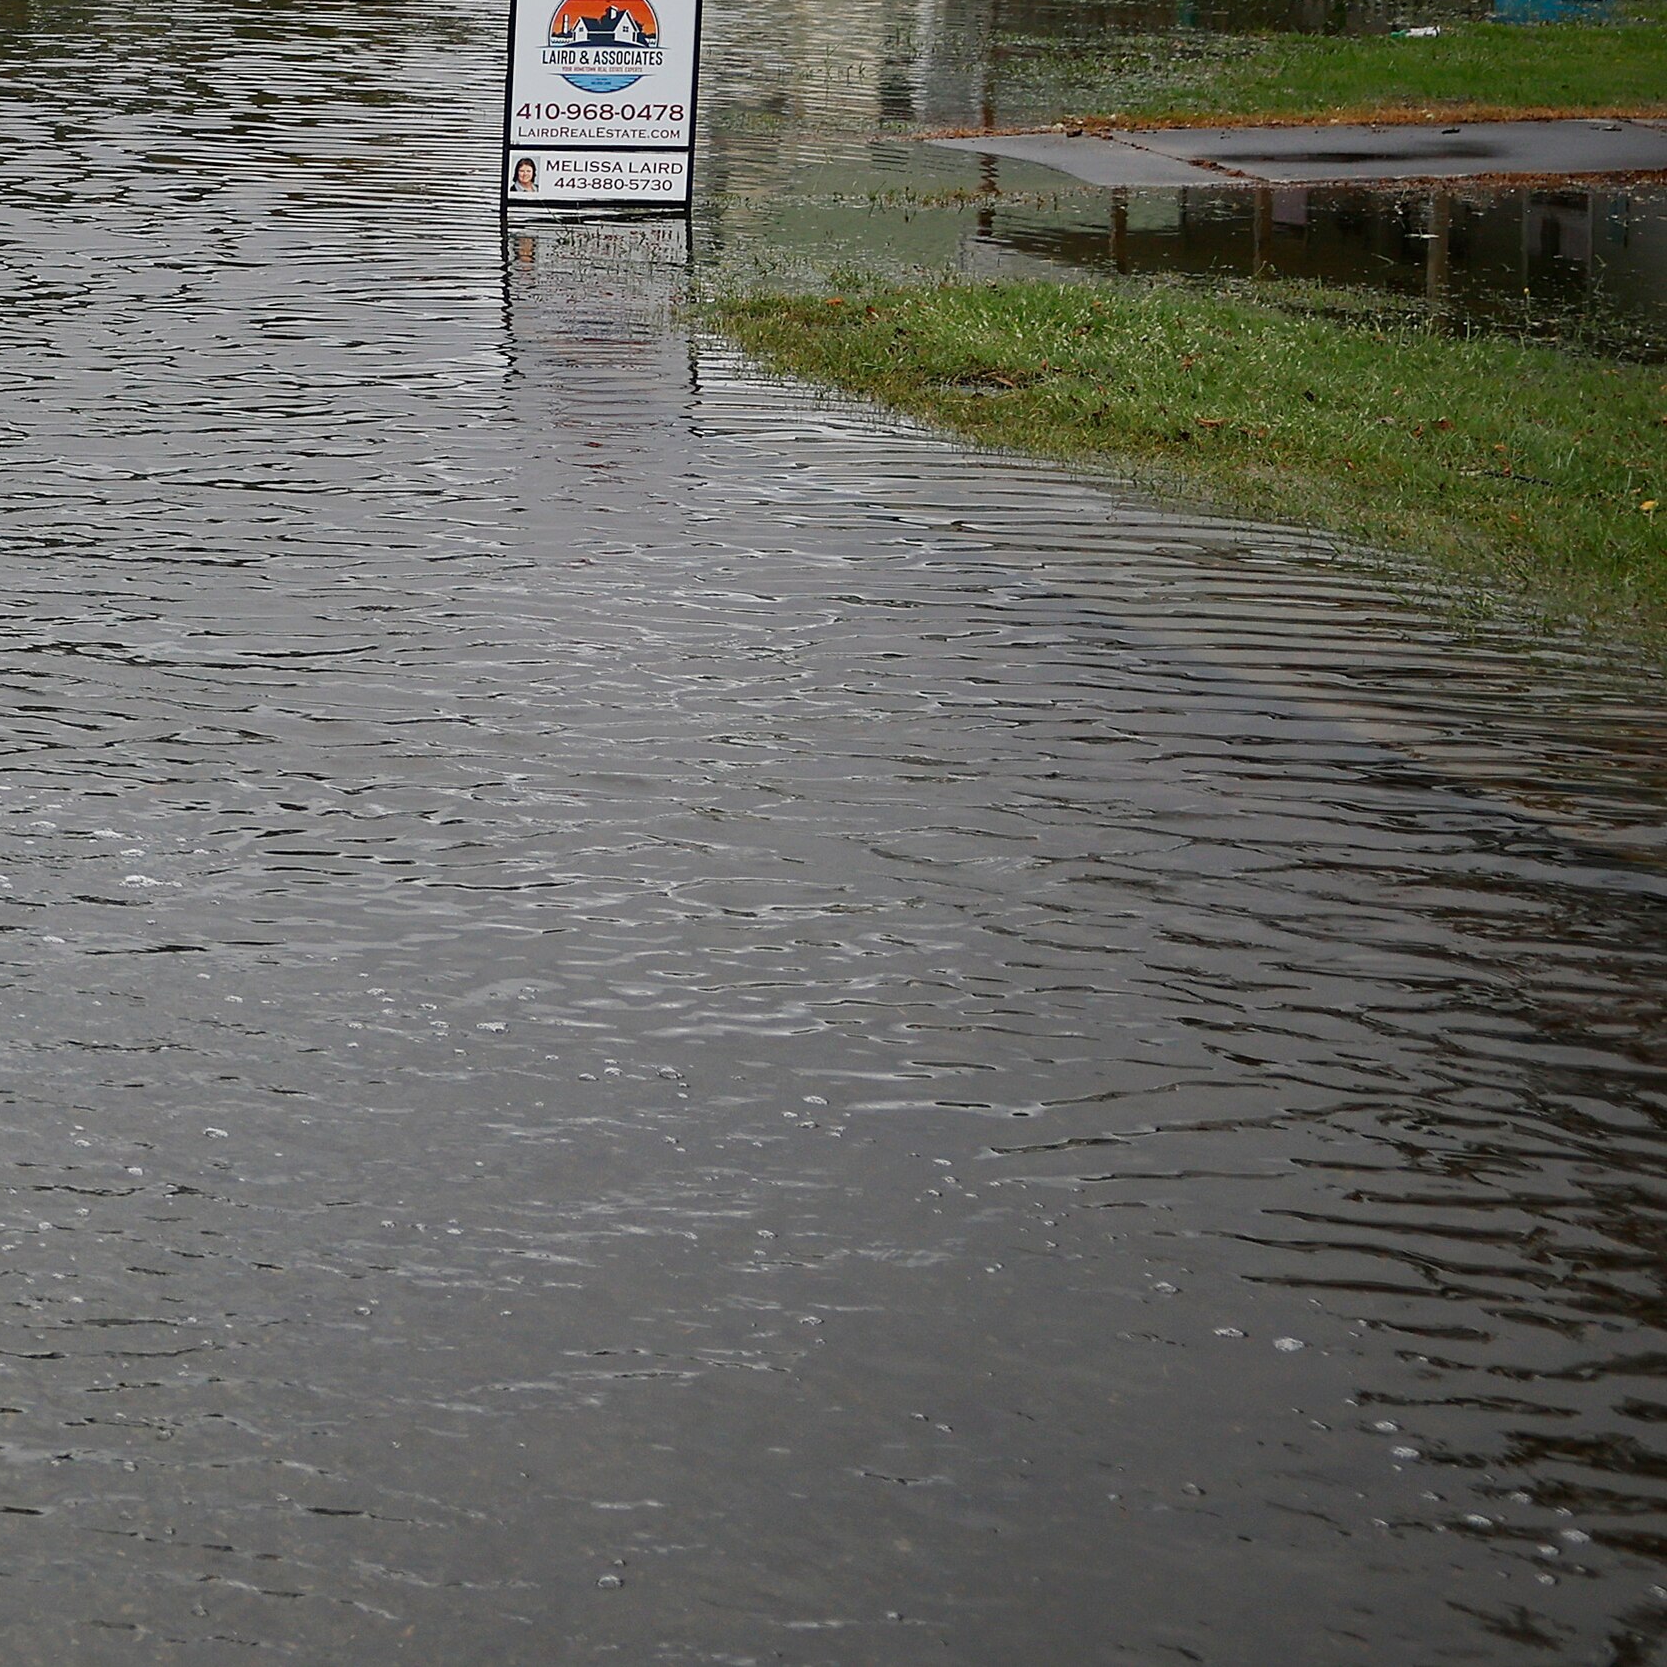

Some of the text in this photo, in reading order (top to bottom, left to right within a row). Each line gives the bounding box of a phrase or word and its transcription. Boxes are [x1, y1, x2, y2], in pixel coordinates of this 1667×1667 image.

[542, 50, 664, 66] LAIRD & ASSOCIATES
[516, 103, 685, 122] 410-968-0478
[546, 160, 684, 175] MELISSA LAIRD
[554, 177, 673, 192] 443-880-5730
